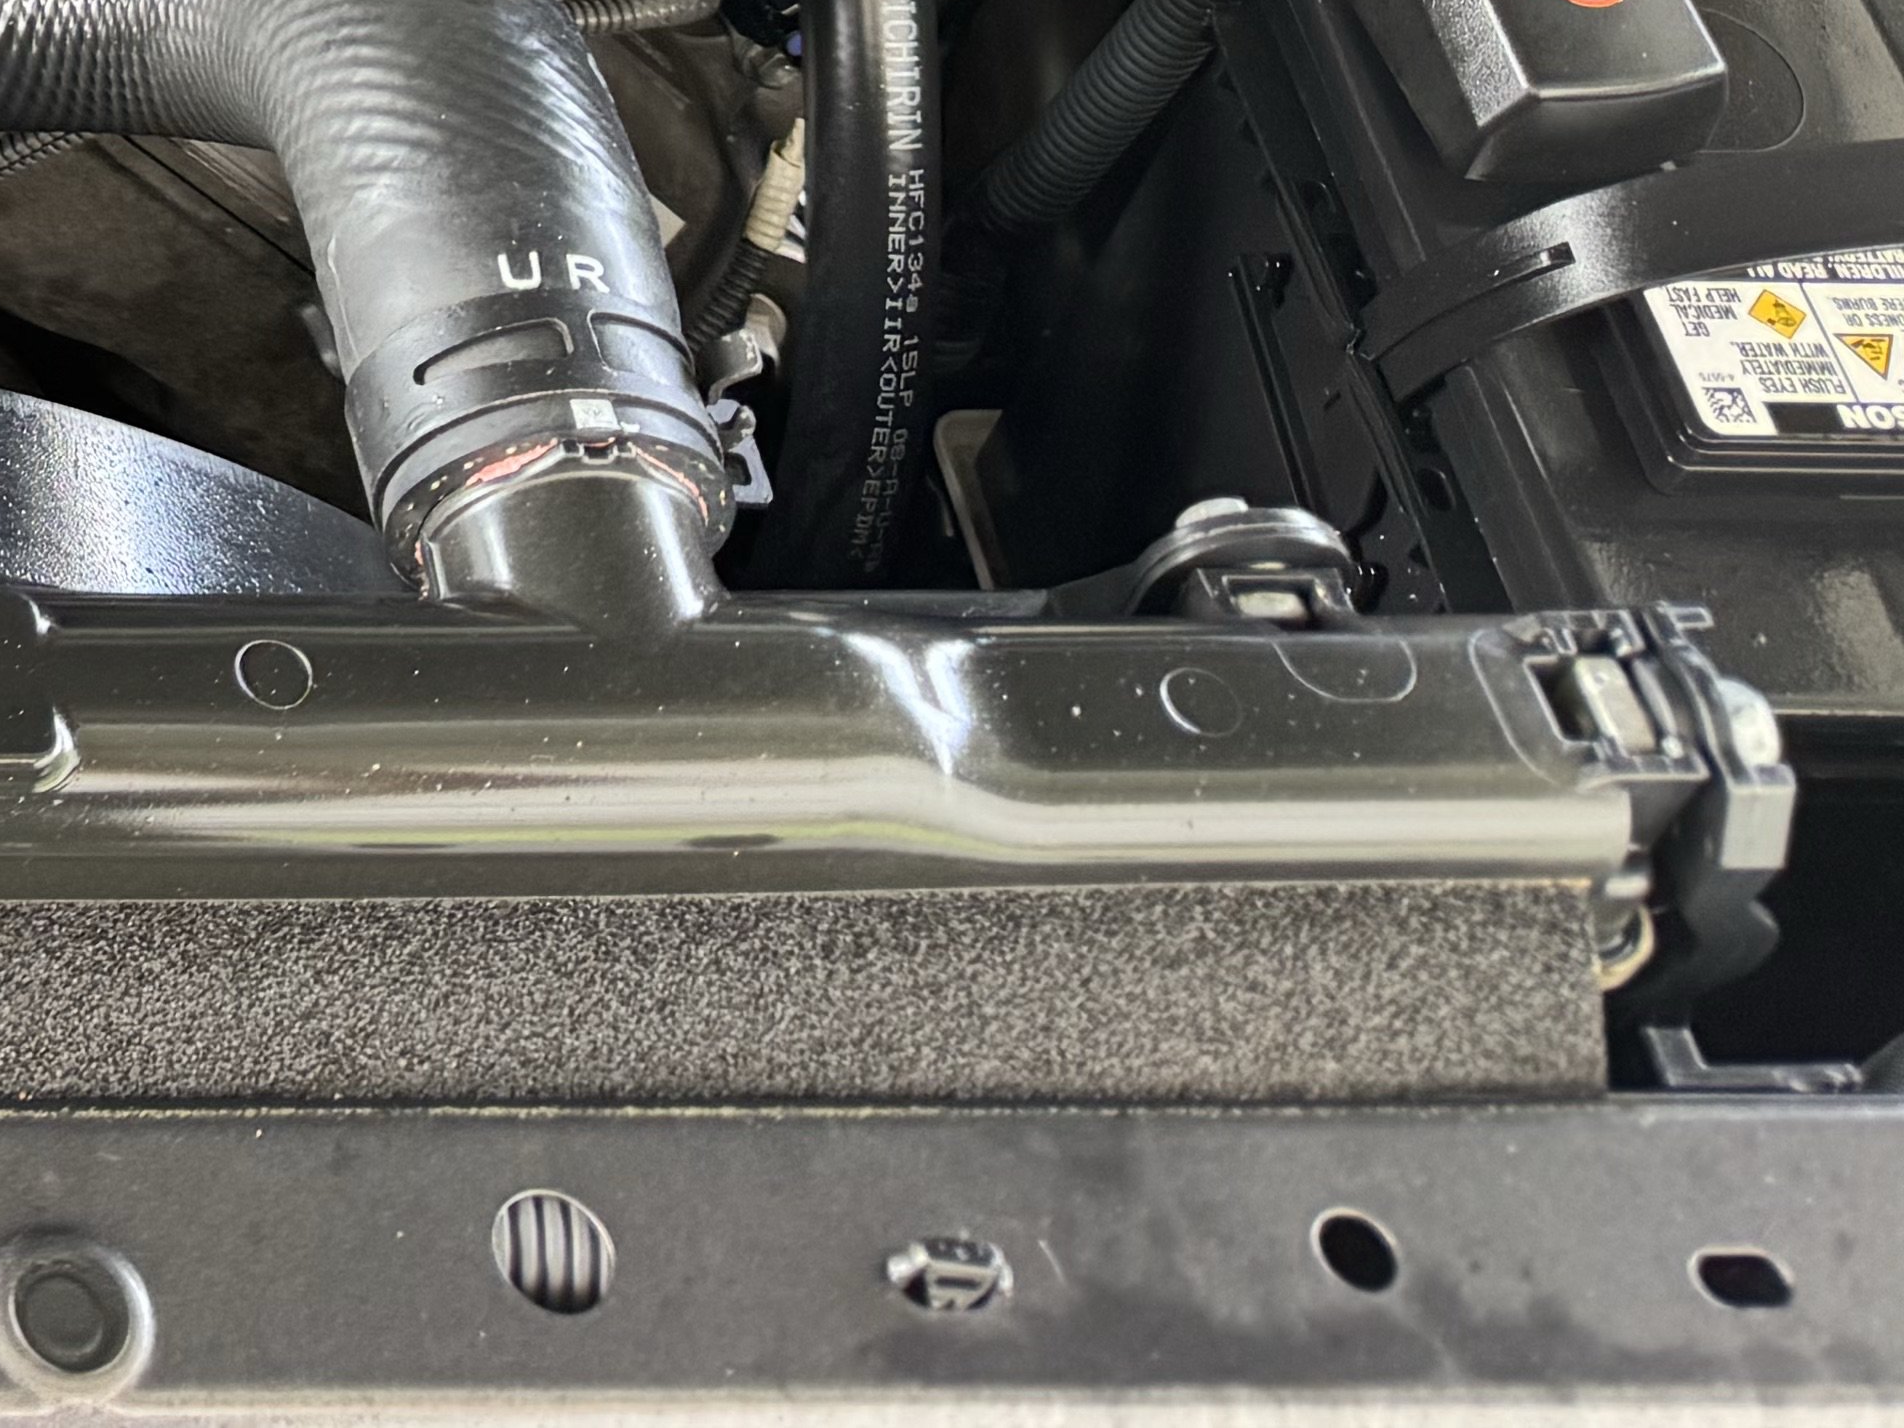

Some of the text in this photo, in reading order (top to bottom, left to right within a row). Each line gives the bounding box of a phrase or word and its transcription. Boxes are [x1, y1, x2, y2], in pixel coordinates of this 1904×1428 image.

[1703, 287, 1741, 302] HELP
[1669, 303, 1737, 319] MEDICAL
[1683, 321, 1709, 337] GET
[1787, 342, 1825, 358] WITH
[1739, 360, 1836, 376] IMMEDIATELY
[1758, 376, 1847, 394] FLUSH EYES
